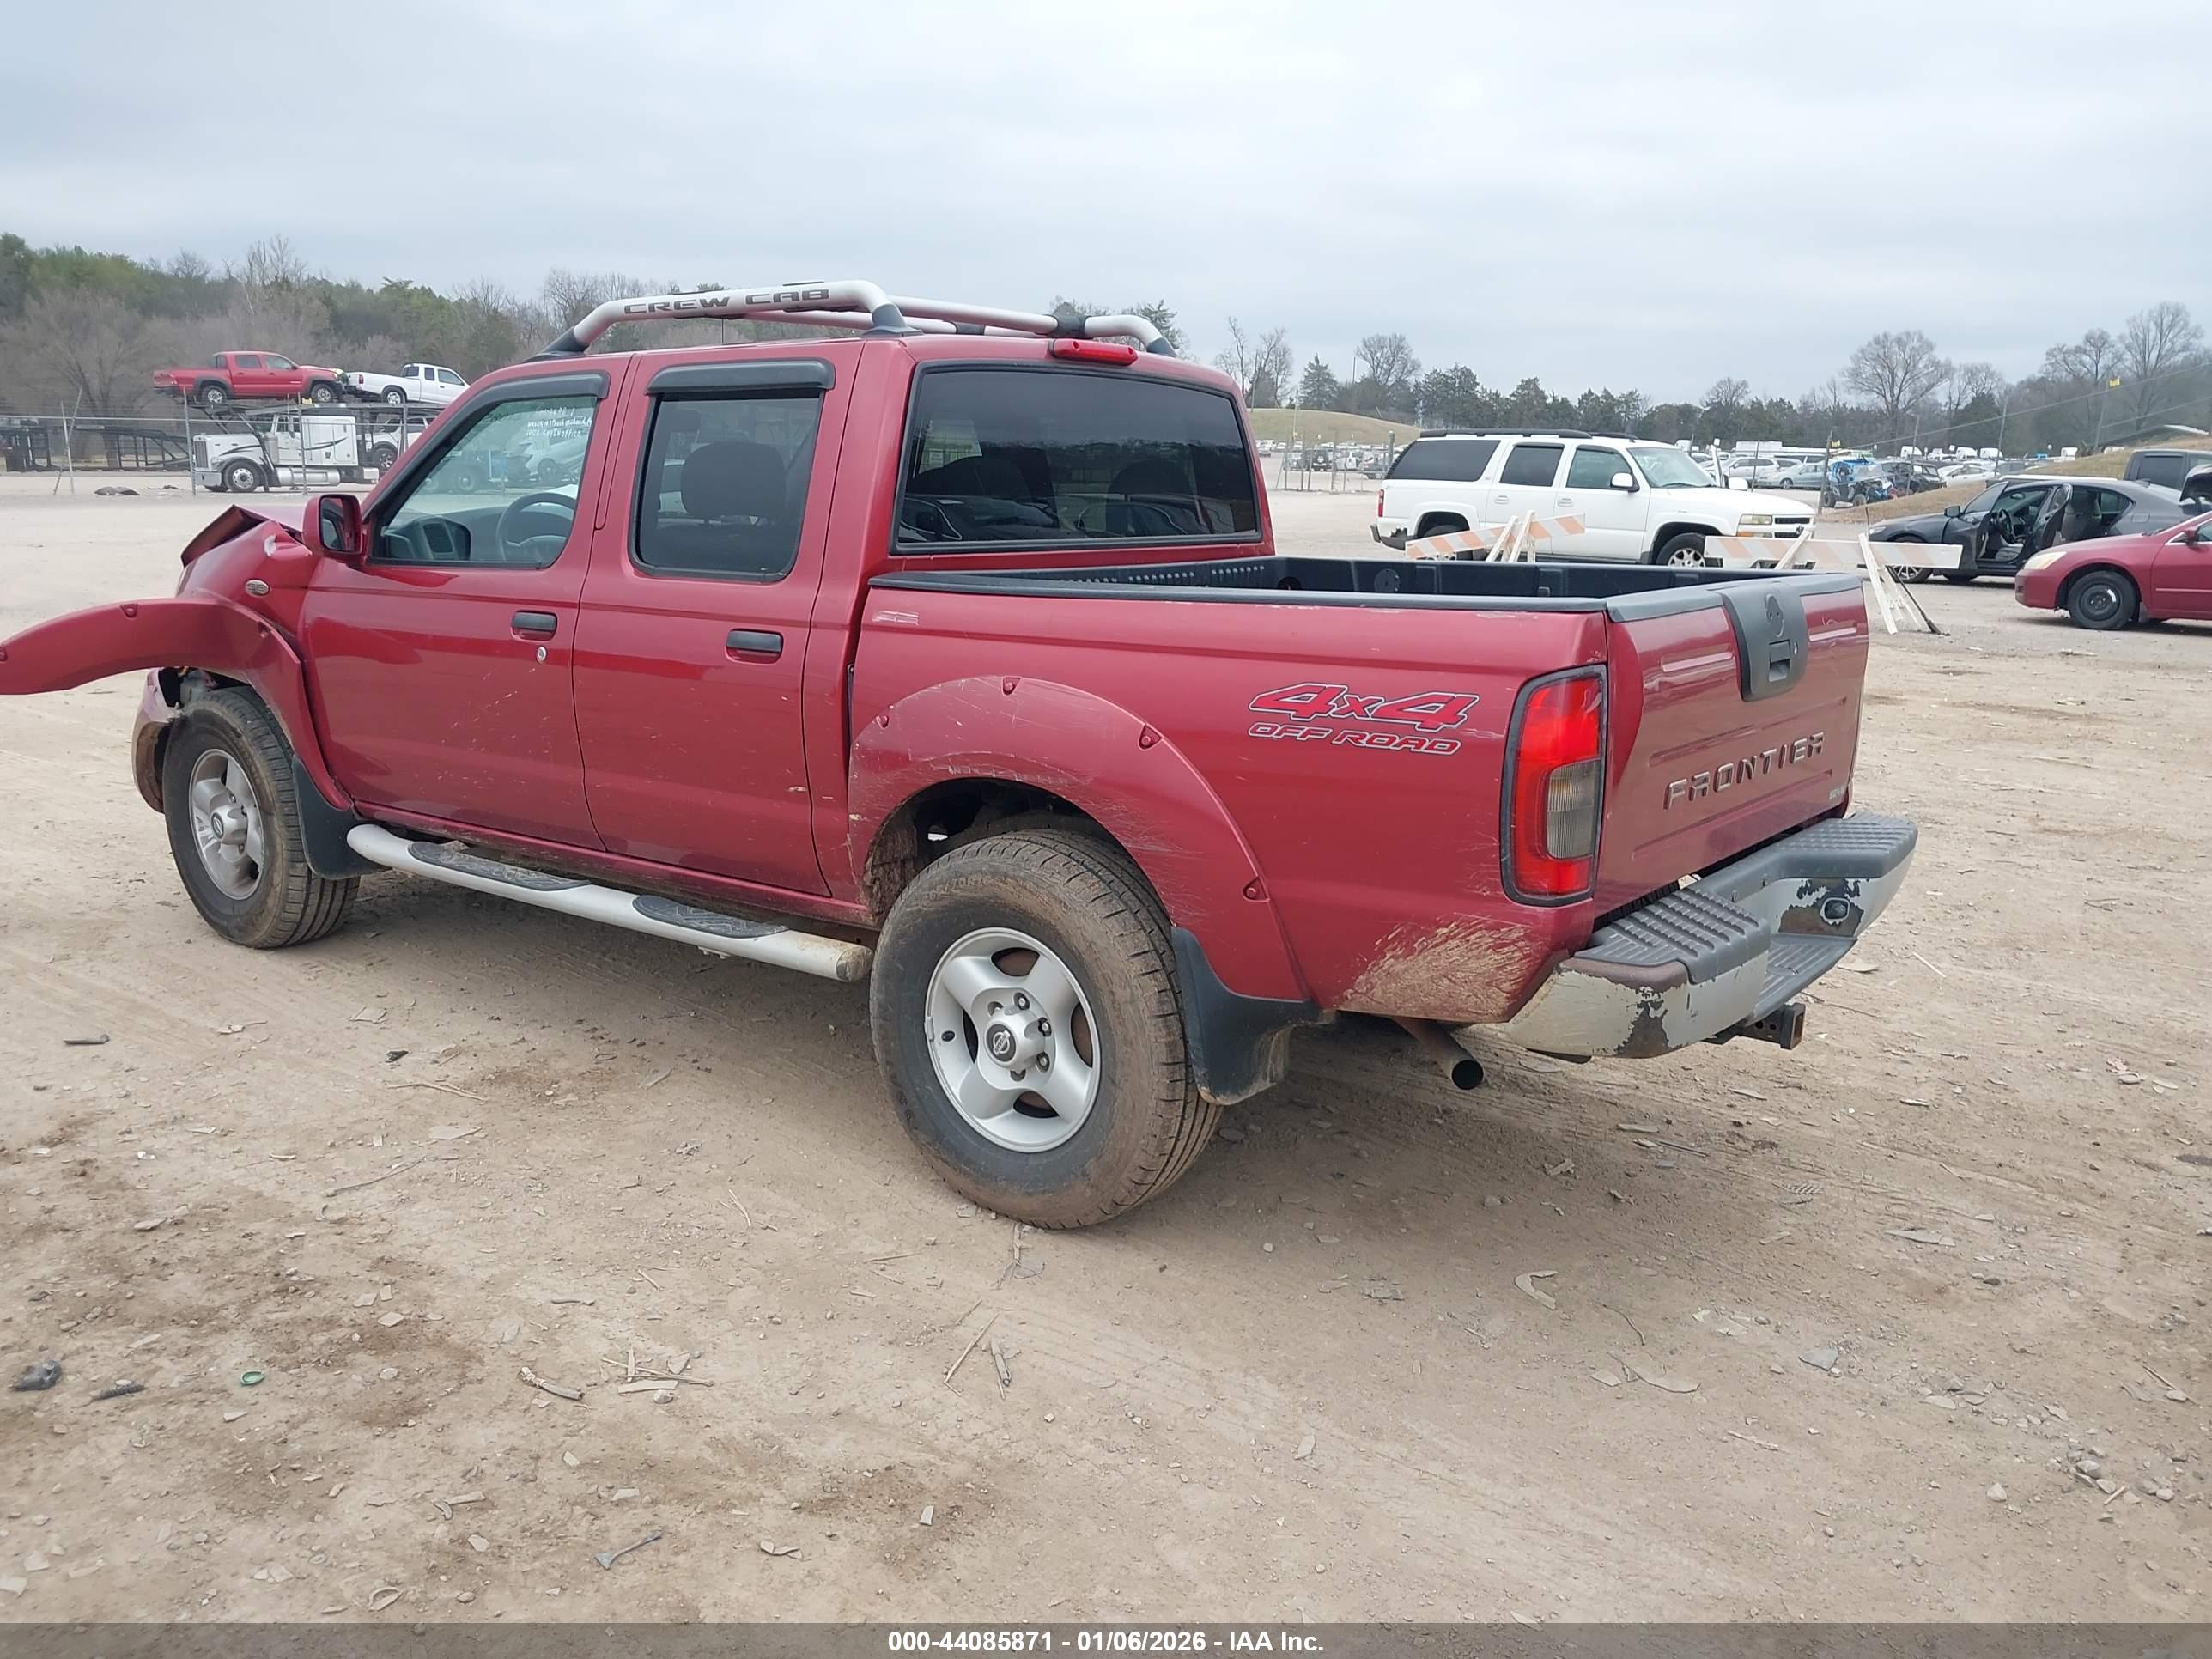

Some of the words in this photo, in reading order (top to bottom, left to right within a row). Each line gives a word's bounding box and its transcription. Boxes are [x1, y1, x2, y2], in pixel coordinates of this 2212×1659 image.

[624, 296, 730, 314] CREW
[745, 289, 830, 305] CAB
[1249, 682, 1480, 732] 4x4
[1248, 722, 1334, 744] OFF
[1331, 729, 1462, 756] ROAD
[1662, 732, 1825, 811] FRONTIER
